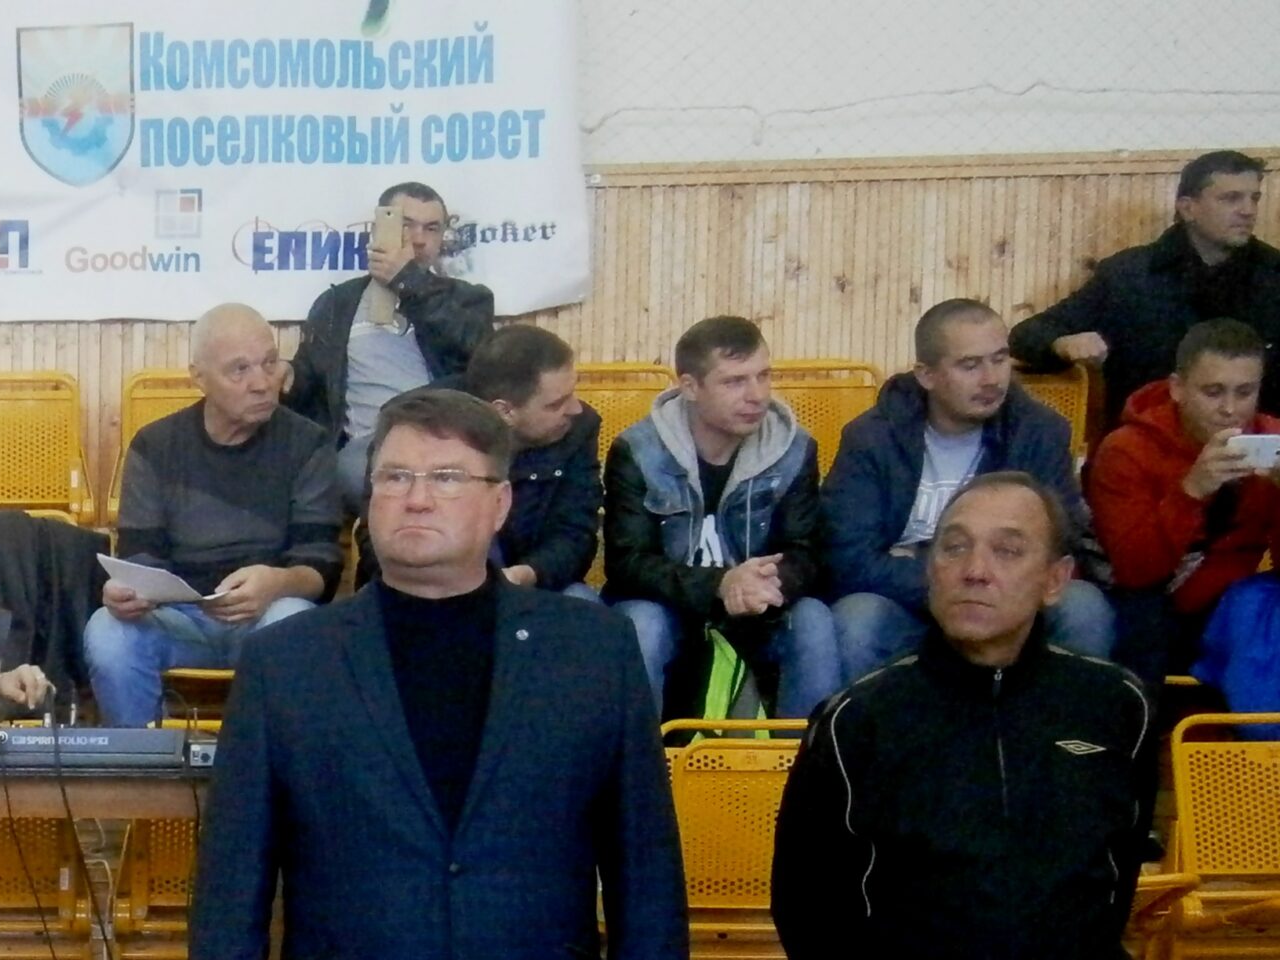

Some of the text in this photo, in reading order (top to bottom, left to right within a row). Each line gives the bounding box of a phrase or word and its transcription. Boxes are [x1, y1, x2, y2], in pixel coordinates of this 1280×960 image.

[139, 20, 495, 92] Комсомольский
[138, 103, 546, 168] поселковый совет
[64, 244, 201, 274] Goodwin
[251, 230, 371, 271] ЕПИК
